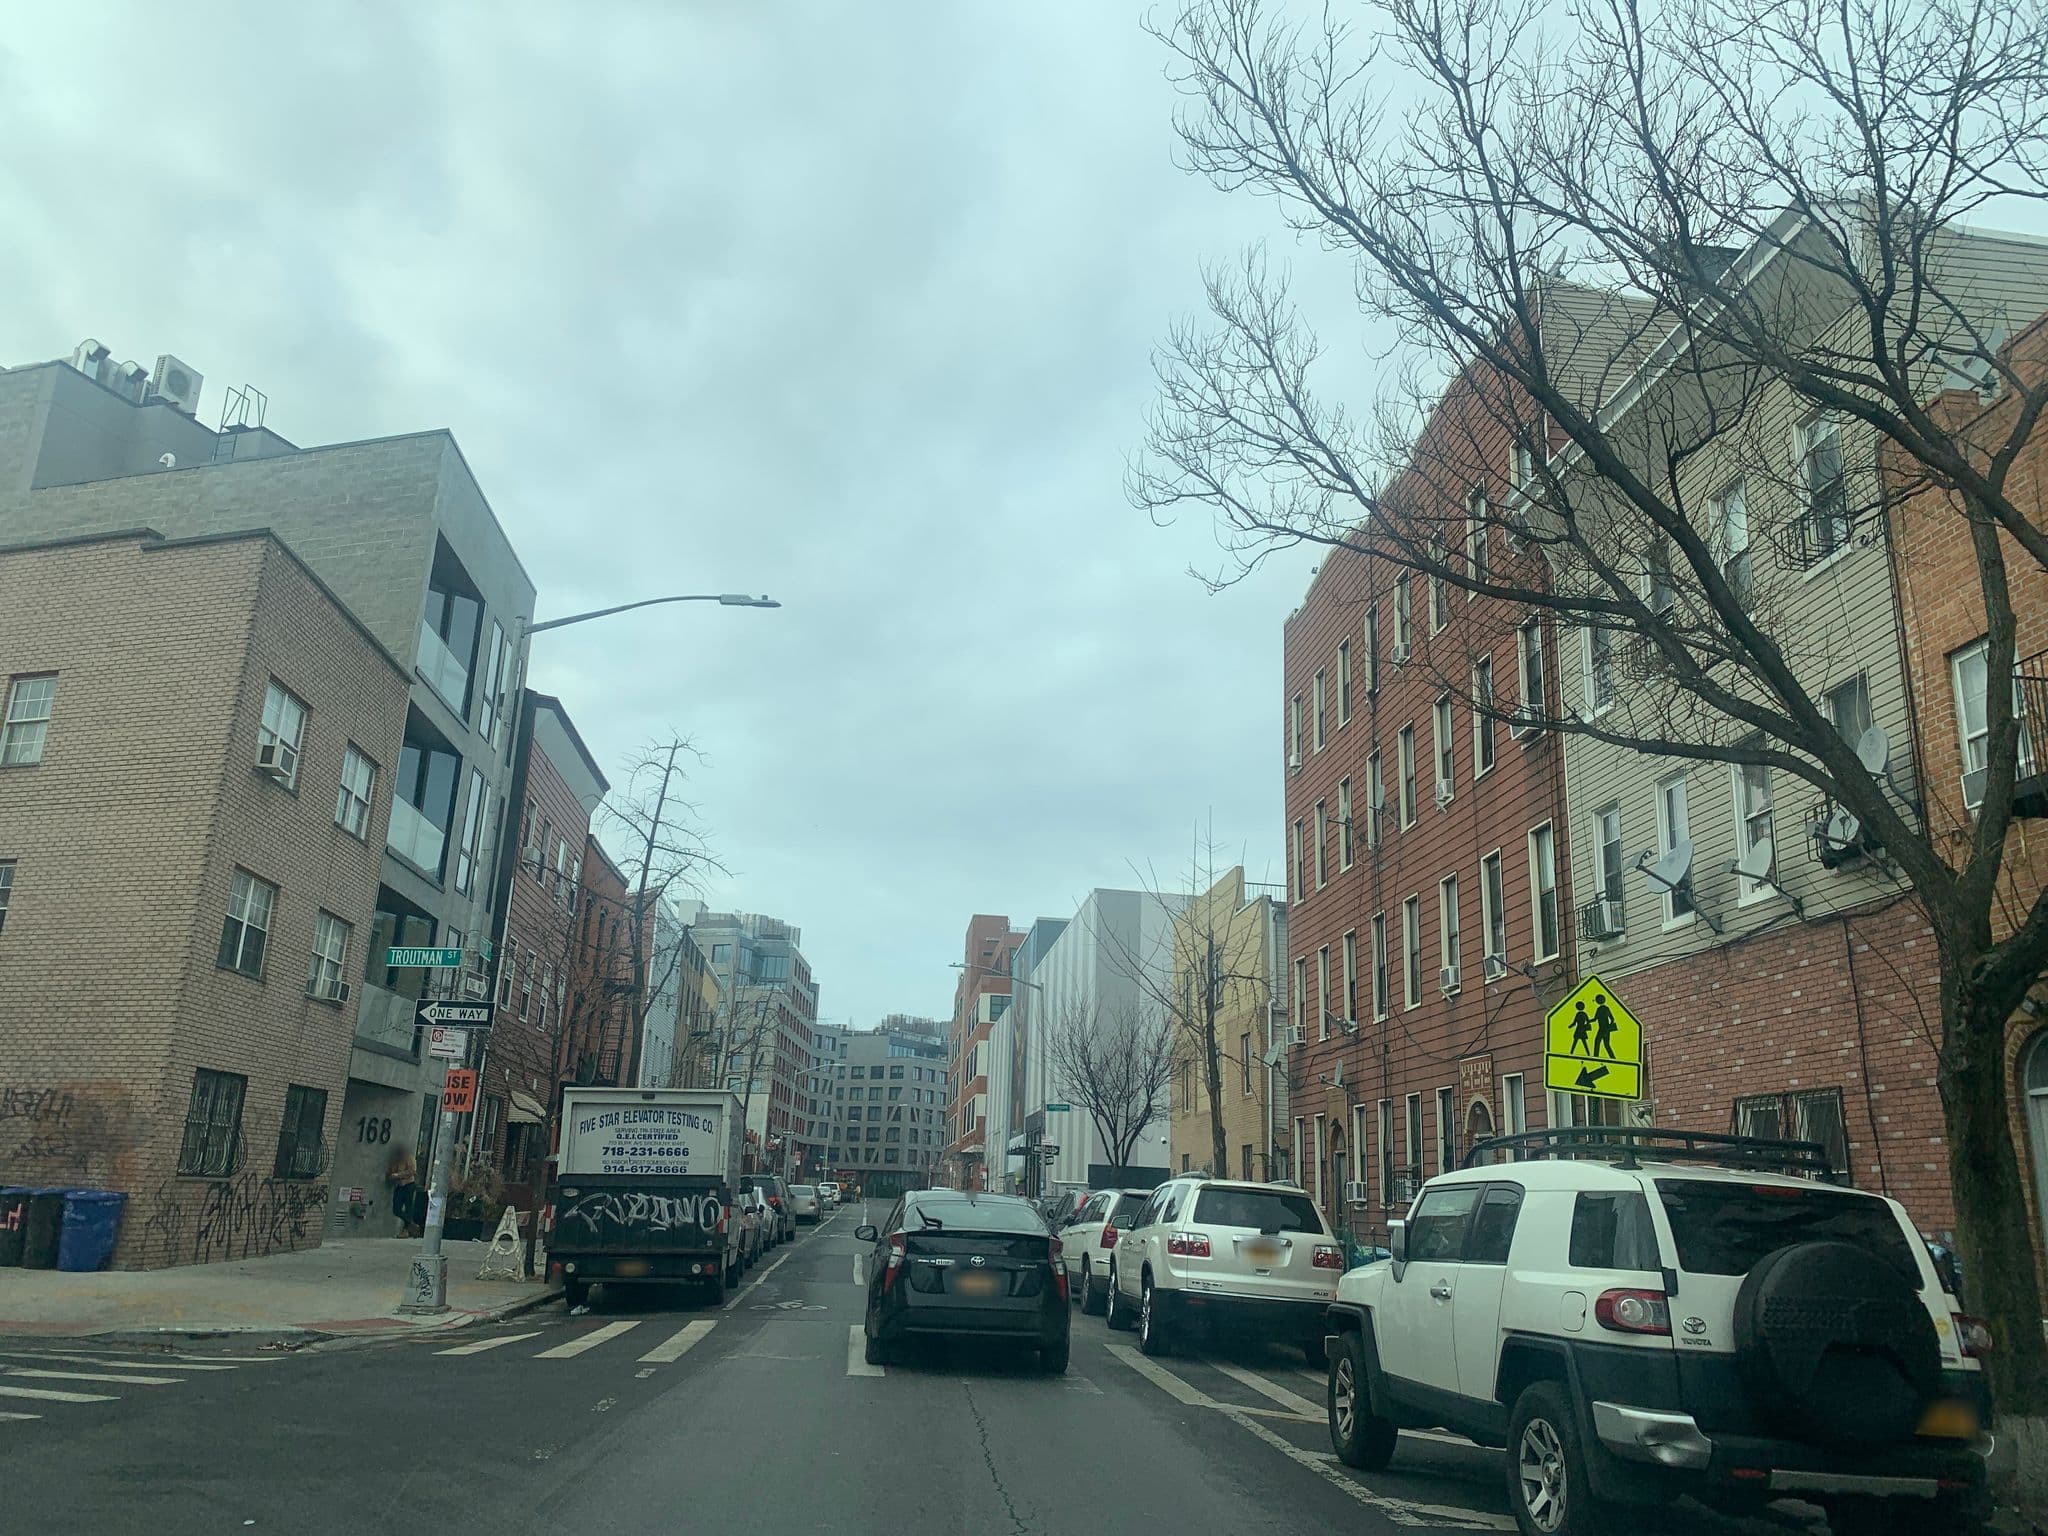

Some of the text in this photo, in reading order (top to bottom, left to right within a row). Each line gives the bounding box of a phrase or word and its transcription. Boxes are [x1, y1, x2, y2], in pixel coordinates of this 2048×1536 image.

[391, 949, 458, 965] TROUTMAN ST
[429, 1007, 483, 1020] ONE WAY
[444, 1075, 471, 1089] ISE
[443, 1092, 468, 1106] OW
[580, 1109, 714, 1135] FIVE STAR ELEVATOR TESTING CO.
[357, 1115, 392, 1145] 168
[602, 1146, 690, 1157] 718-231-6666
[603, 1165, 688, 1174] 914-617-8666
[1681, 1337, 1712, 1347] TOYOTA
